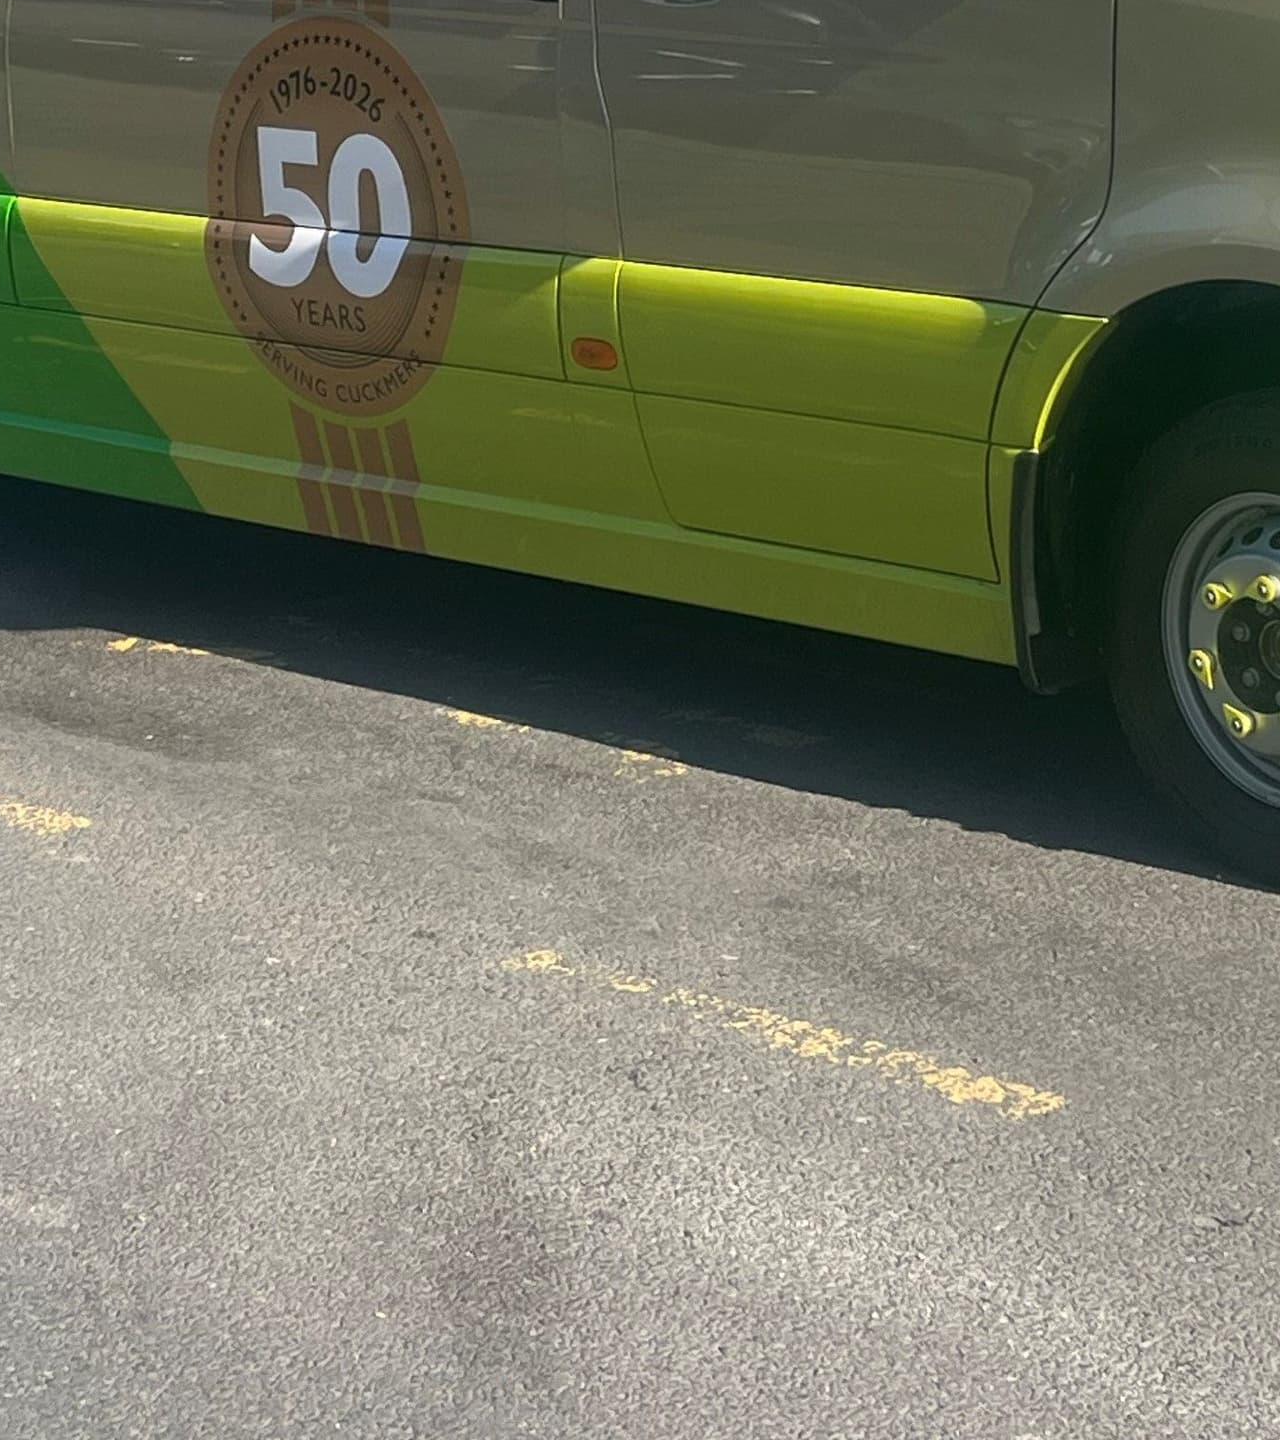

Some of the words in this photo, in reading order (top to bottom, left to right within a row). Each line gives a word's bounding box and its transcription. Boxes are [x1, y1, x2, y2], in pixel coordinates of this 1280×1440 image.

[269, 65, 386, 123] 1976-2026
[248, 125, 412, 299] 50
[291, 296, 367, 333] YEARS
[256, 331, 328, 398] SERVING
